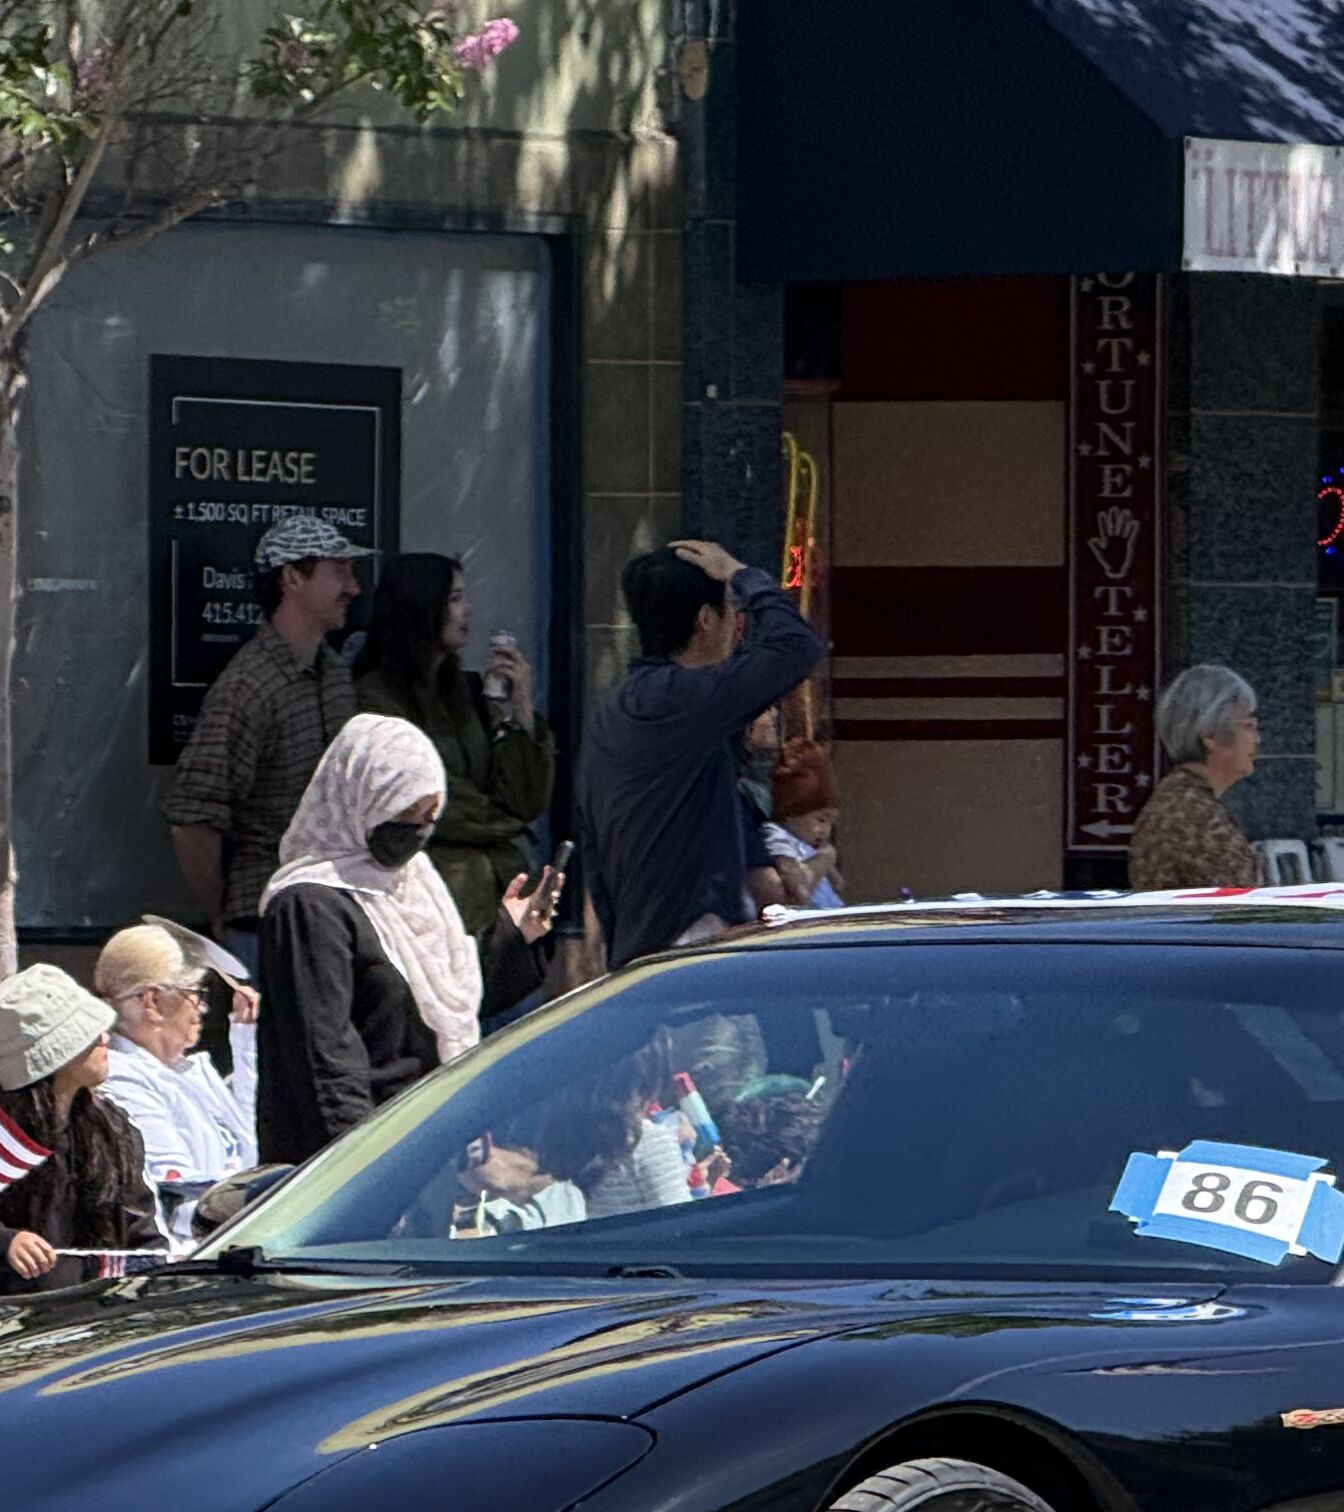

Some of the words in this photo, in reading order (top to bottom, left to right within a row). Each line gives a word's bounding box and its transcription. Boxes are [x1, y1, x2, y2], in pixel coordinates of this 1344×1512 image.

[174, 446, 230, 481] FOR
[236, 449, 318, 485] LEASE
[227, 503, 249, 527] SQ
[252, 504, 271, 523] FT
[321, 506, 367, 527] SPACE
[203, 566, 245, 589] Davis
[1091, 585, 1134, 813] TELLER
[1181, 1172, 1284, 1225] 86
